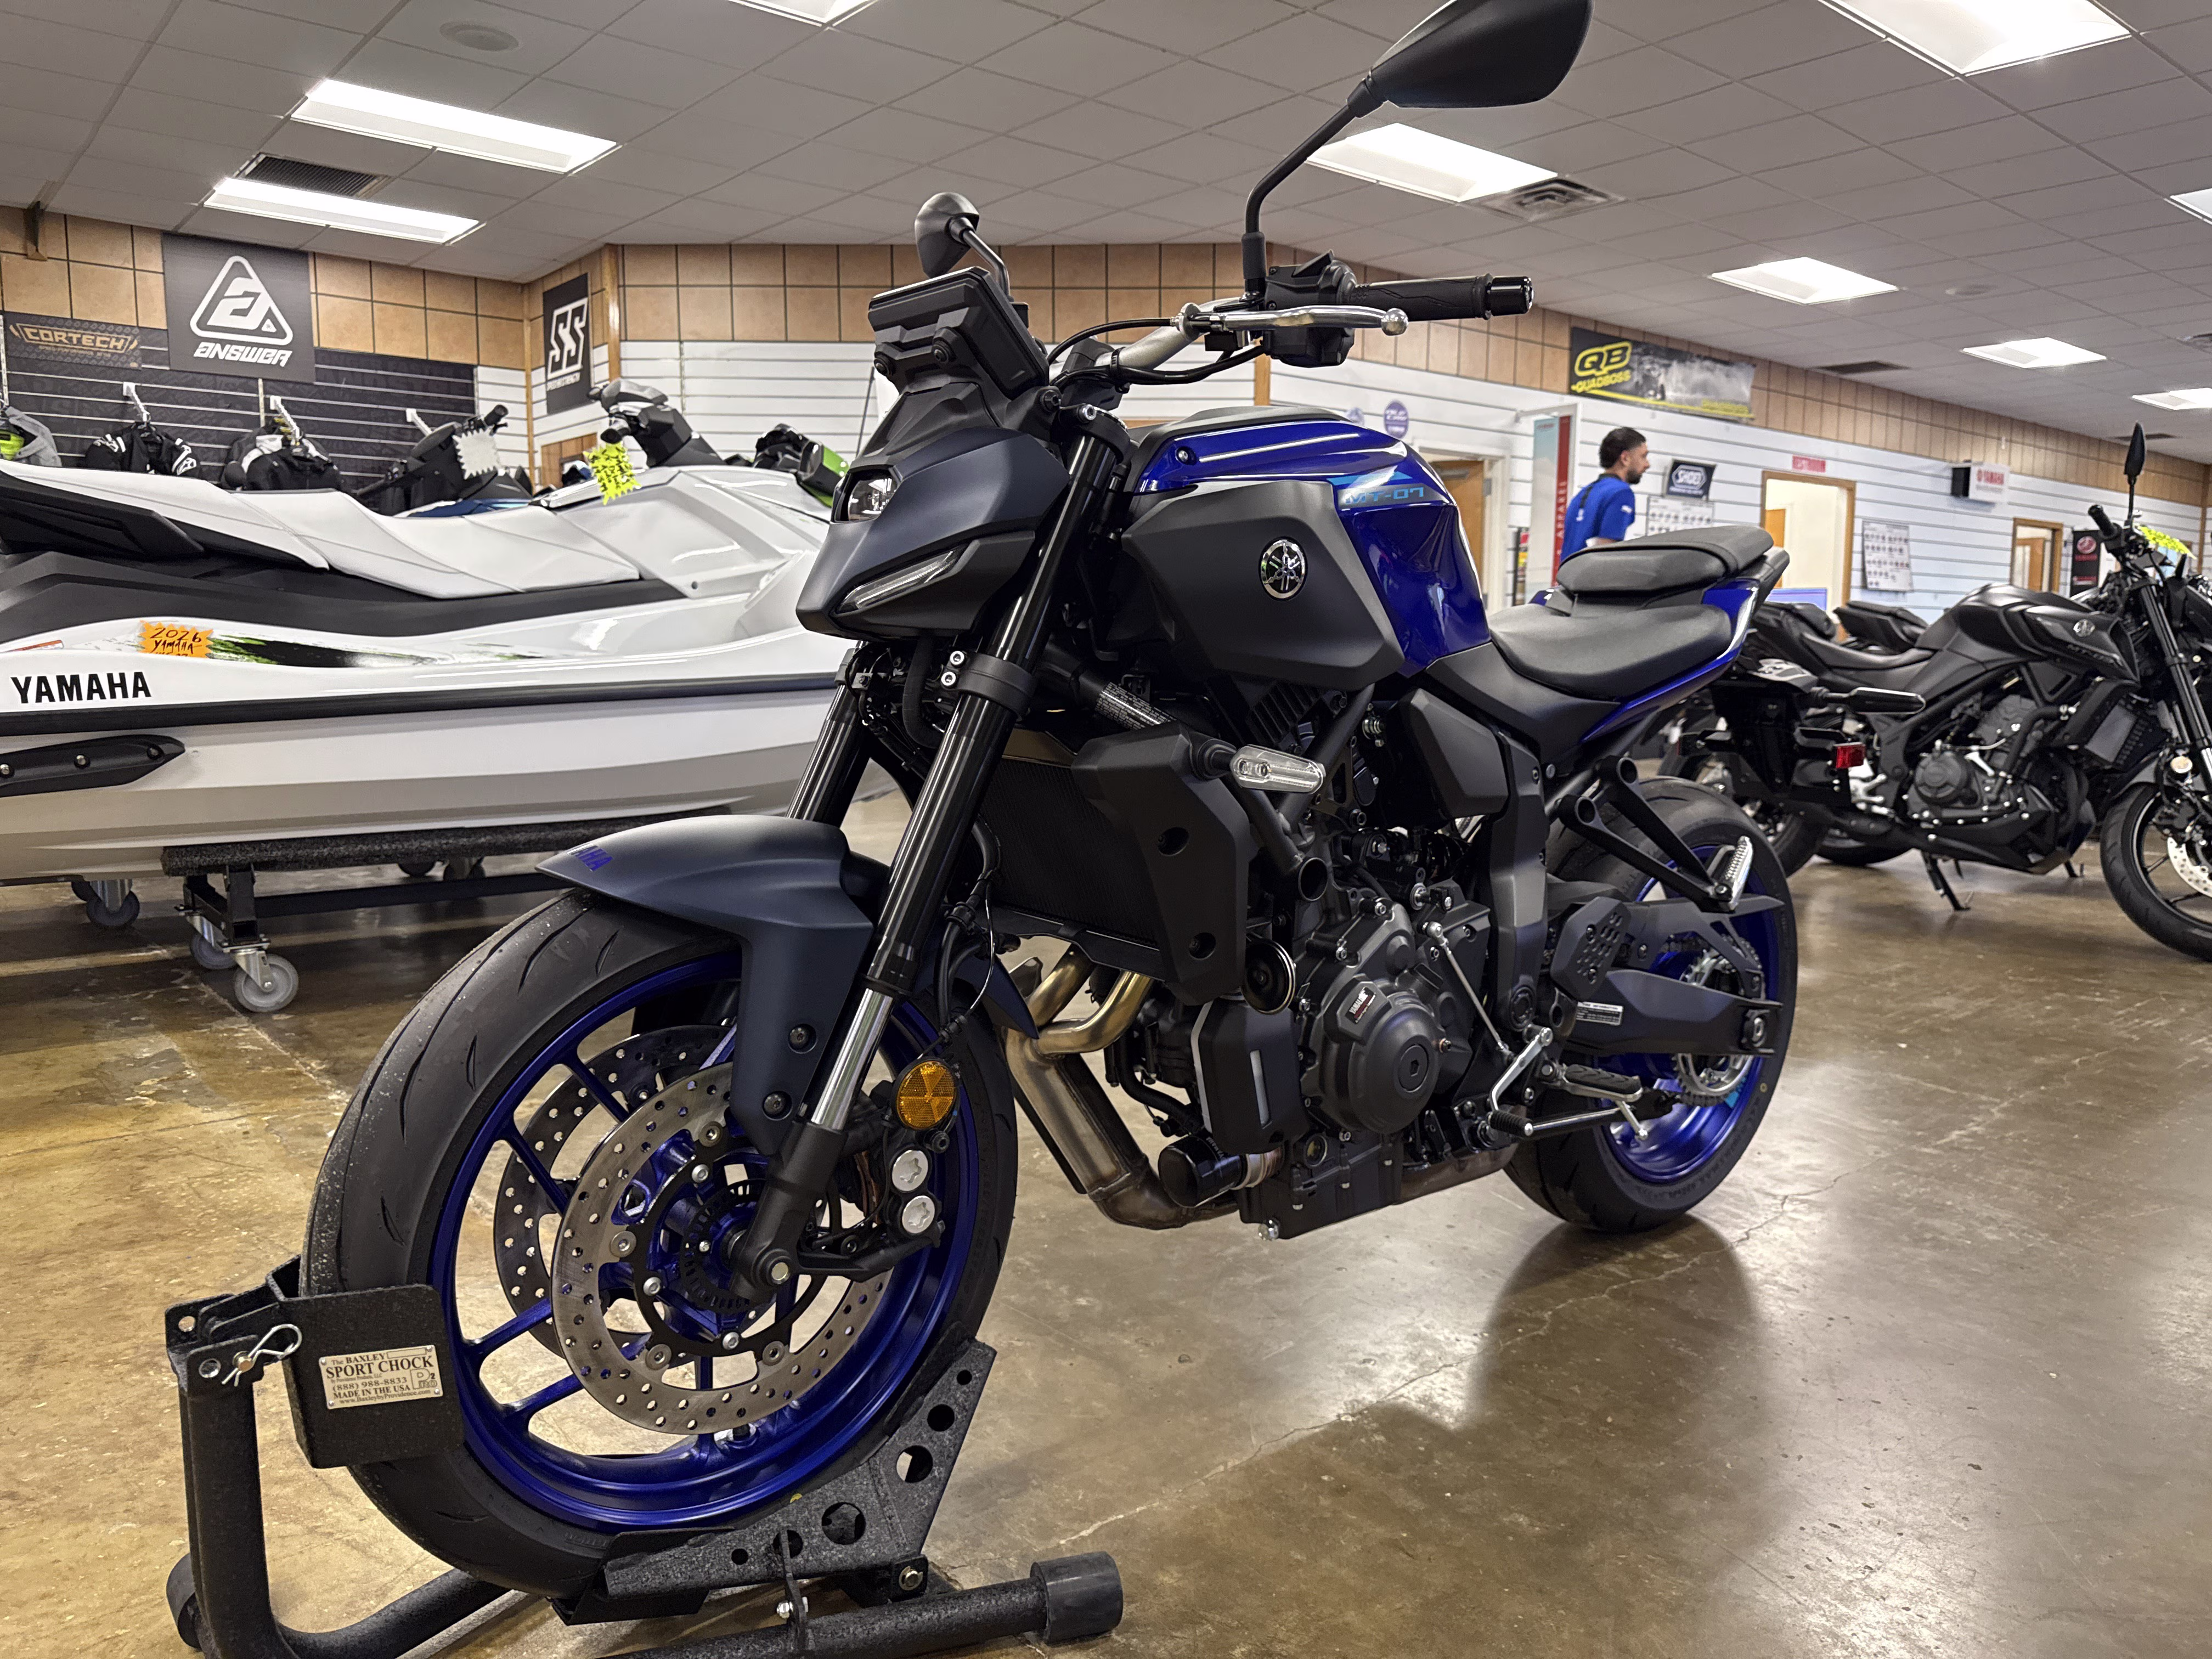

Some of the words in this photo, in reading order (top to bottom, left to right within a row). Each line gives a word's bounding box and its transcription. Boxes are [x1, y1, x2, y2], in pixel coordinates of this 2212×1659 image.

[24, 328, 125, 349] CORTECH
[1574, 341, 1632, 376] QB
[1345, 487, 1424, 504] MT-07
[149, 627, 202, 643] 2026
[10, 671, 152, 704] YAMAHA
[346, 1352, 386, 1364] BAXLEY
[326, 1362, 374, 1379] SPORT
[378, 1356, 434, 1373] CHOCK
[332, 1383, 359, 1392] (888)
[362, 1377, 407, 1387] 988-8833
[333, 1390, 361, 1400] MADE
[375, 1386, 392, 1395] THE
[393, 1384, 410, 1393] USA
